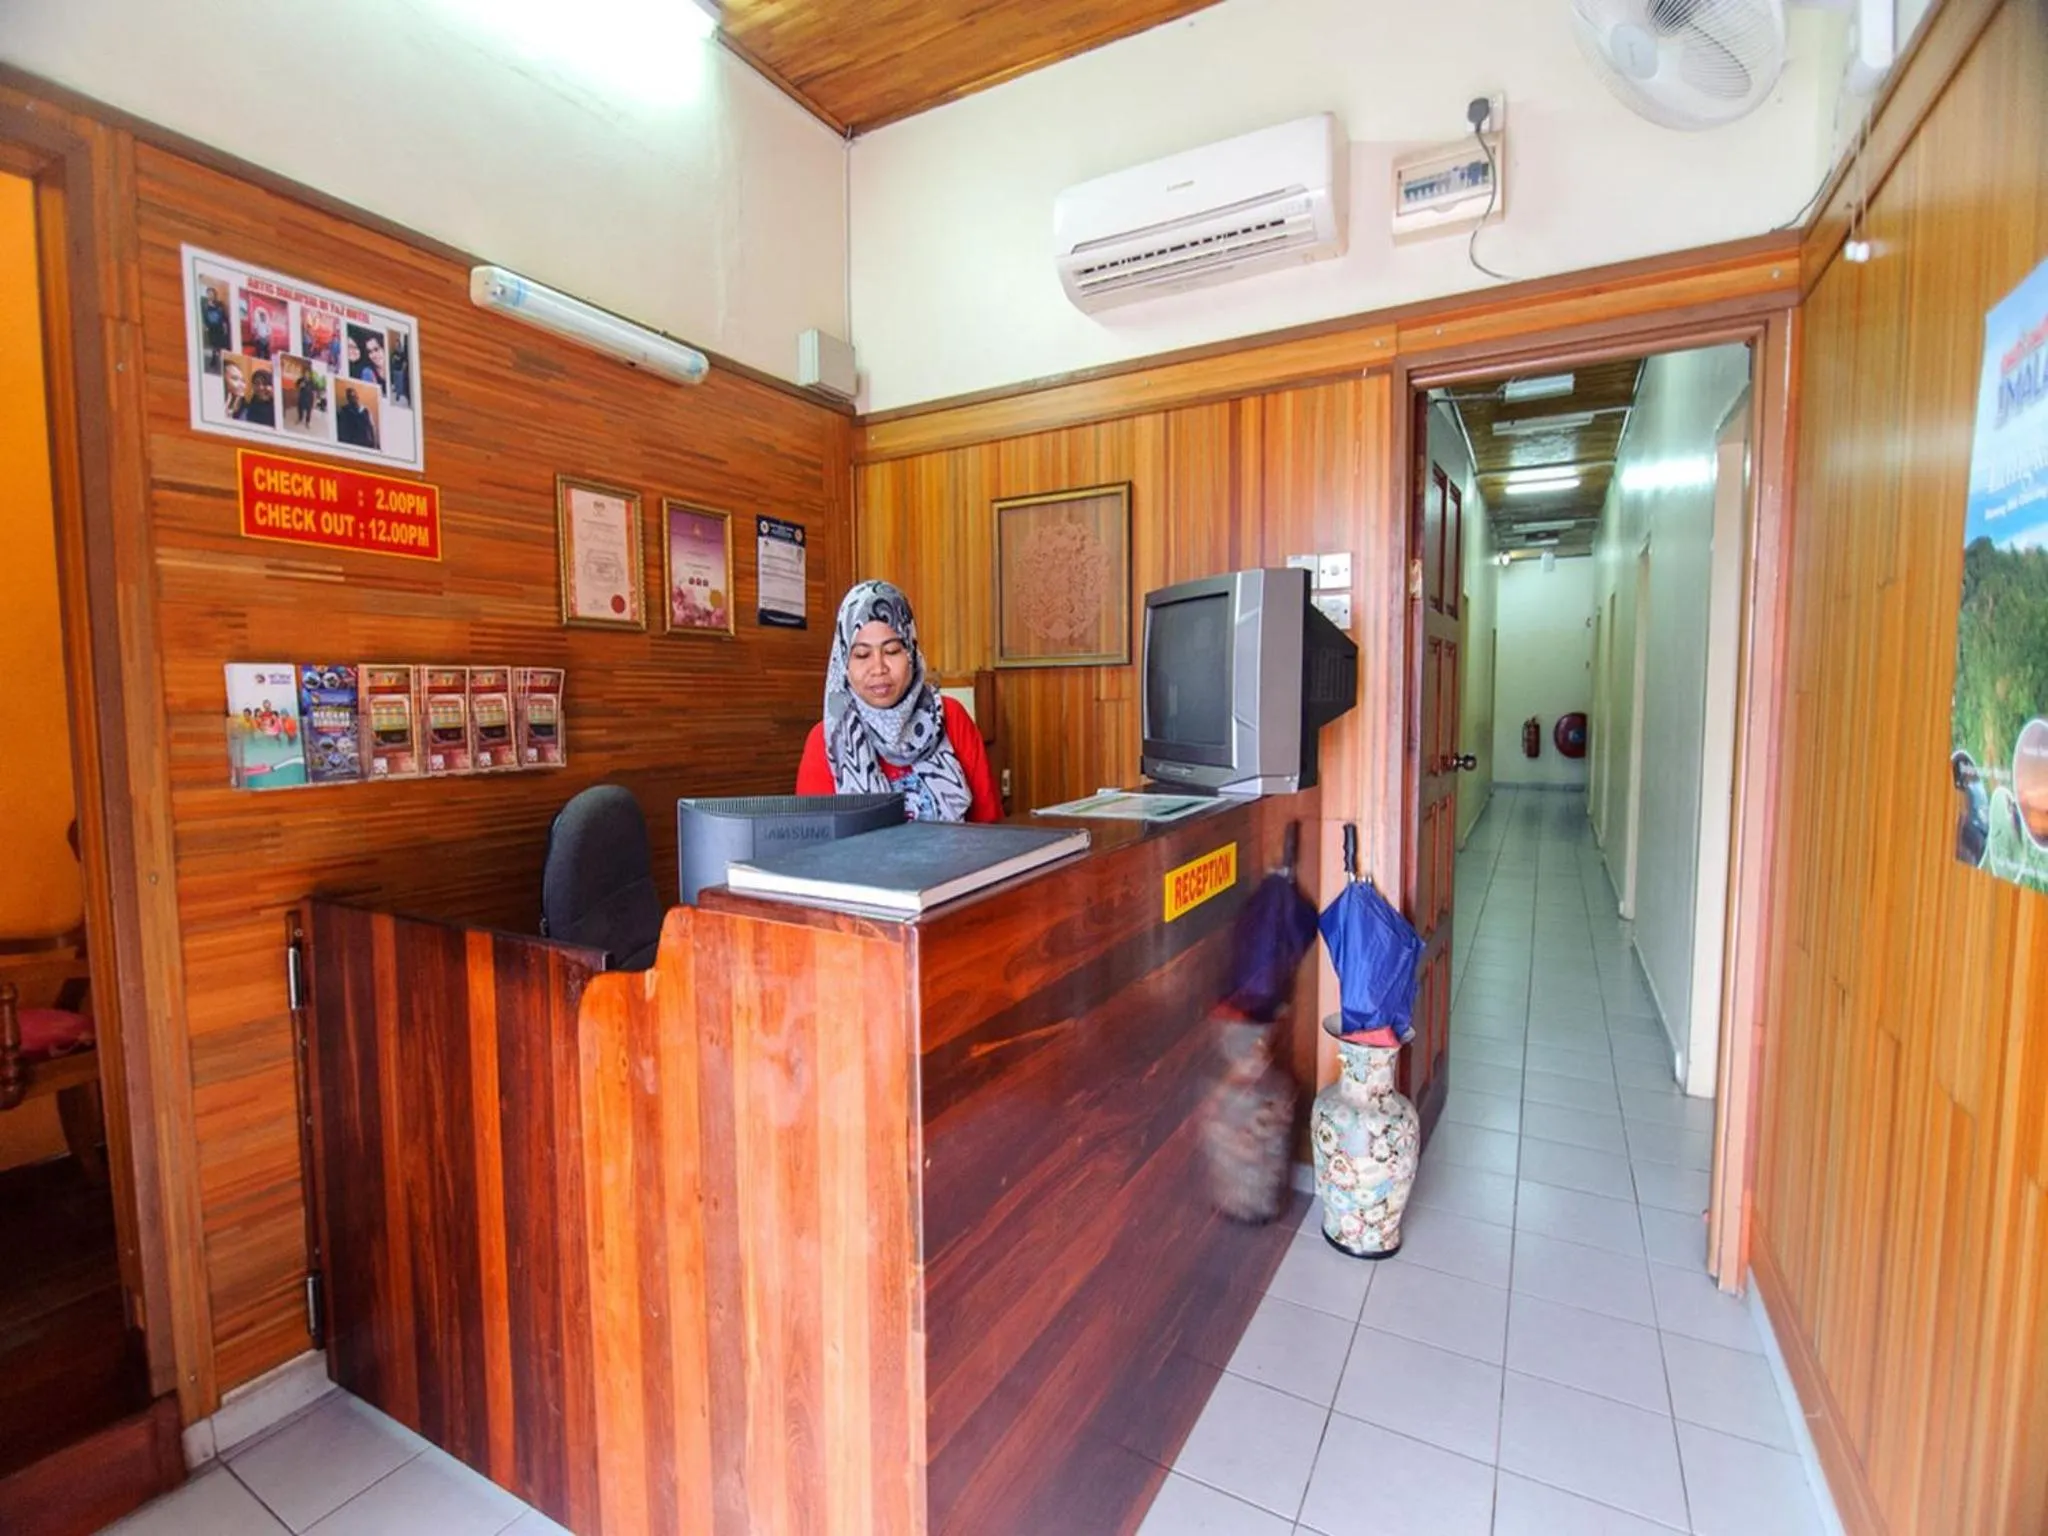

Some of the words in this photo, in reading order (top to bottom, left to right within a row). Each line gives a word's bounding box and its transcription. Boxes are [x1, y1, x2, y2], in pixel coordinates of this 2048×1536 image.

[253, 466, 317, 499] CHECK
[320, 478, 339, 503] IN
[374, 487, 428, 517] 2.00PM
[254, 501, 317, 533] CHECK
[320, 510, 356, 538] OUT
[368, 517, 430, 547] 12.00PM
[1174, 852, 1230, 912] RECEPTION
